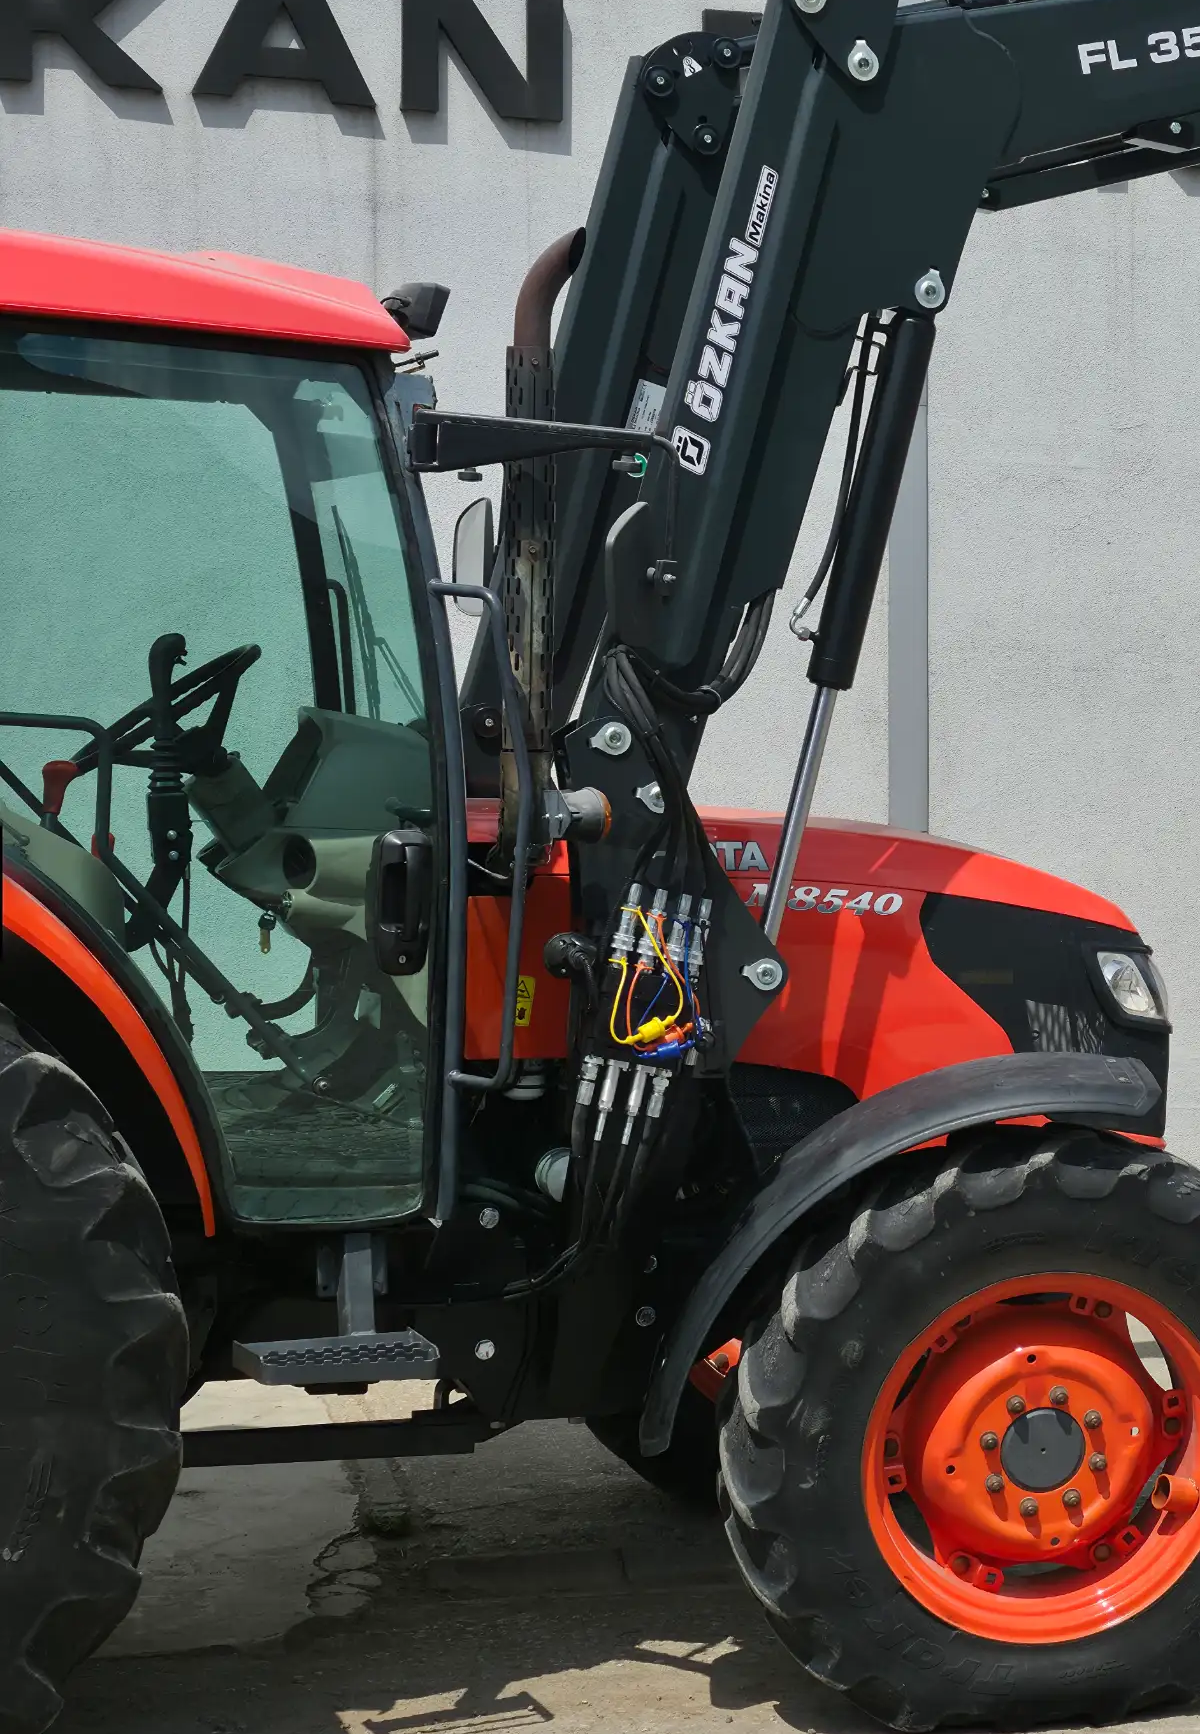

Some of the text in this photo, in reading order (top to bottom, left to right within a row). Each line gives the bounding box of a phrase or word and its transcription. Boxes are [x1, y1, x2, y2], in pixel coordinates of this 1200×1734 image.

[1077, 39, 1138, 75] FL
[684, 237, 759, 423] ÖZKAN
[749, 172, 775, 245] Makina
